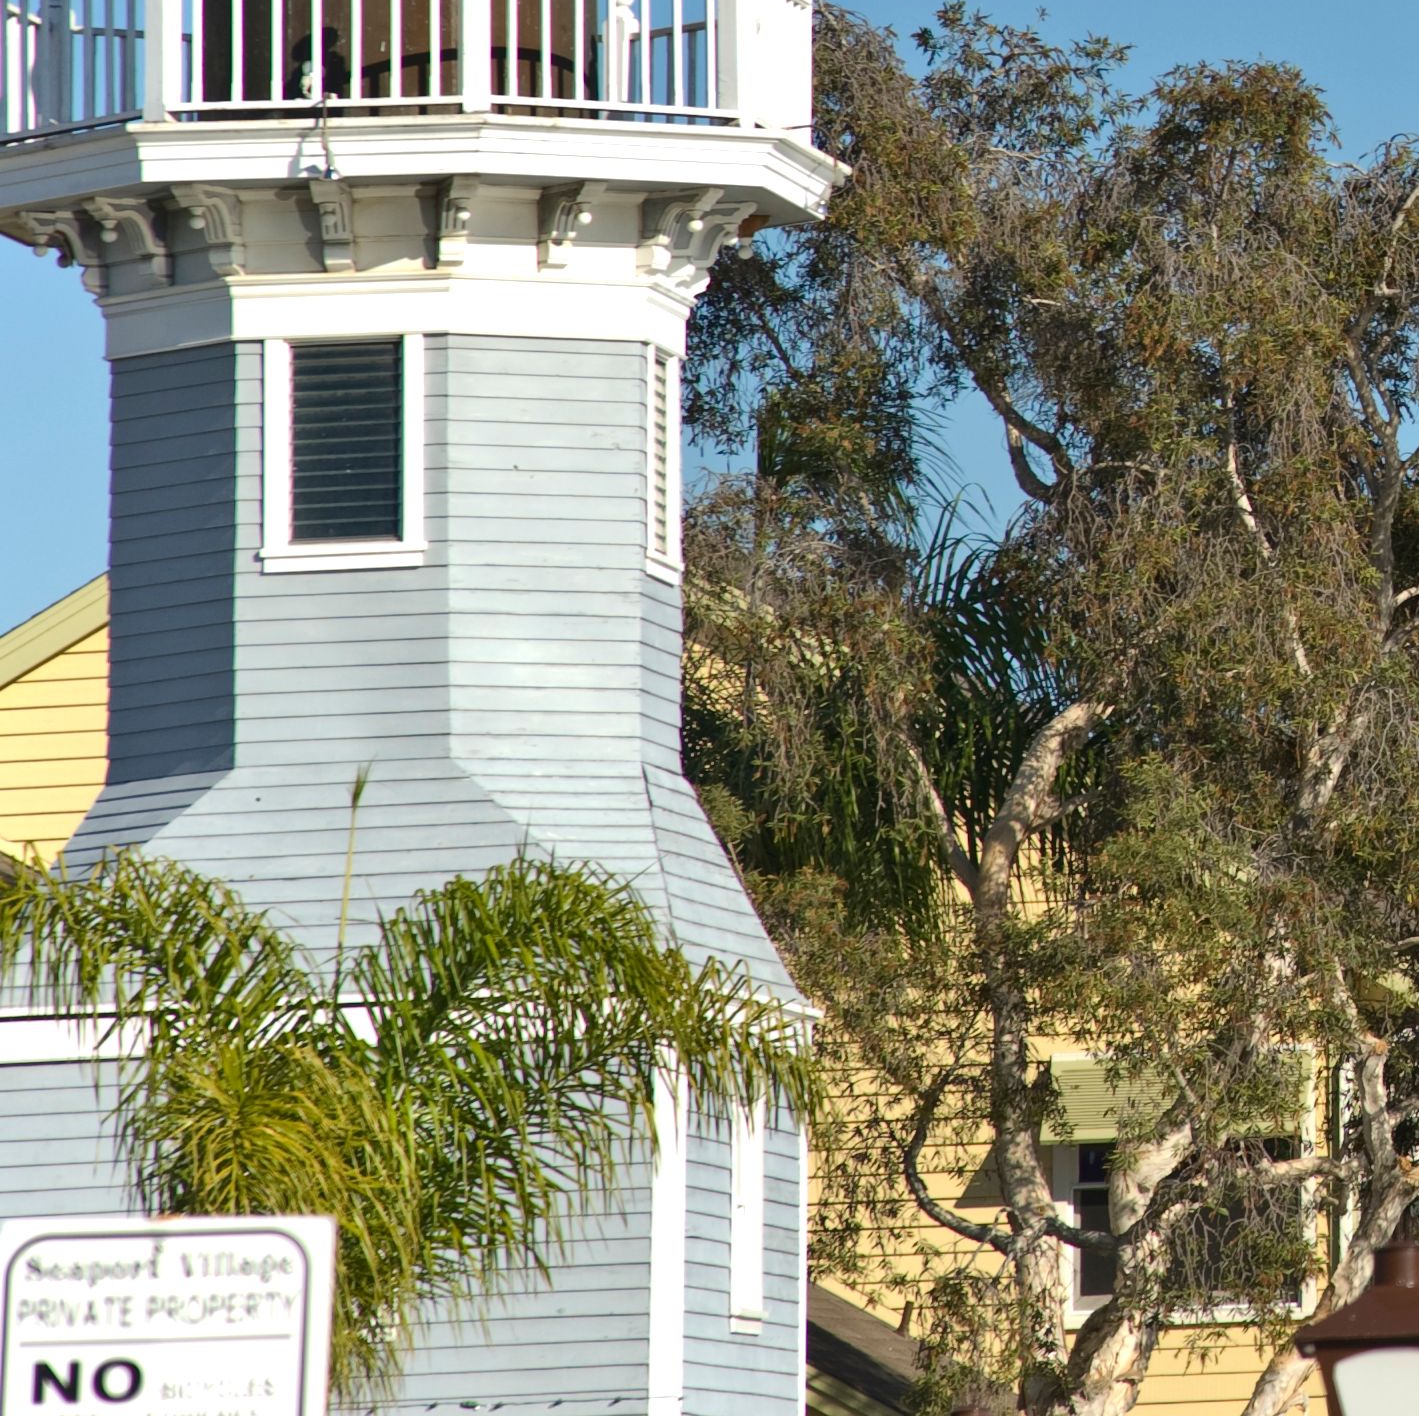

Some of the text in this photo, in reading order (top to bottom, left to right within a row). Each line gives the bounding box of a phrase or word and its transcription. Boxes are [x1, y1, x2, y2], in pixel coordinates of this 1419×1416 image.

[25, 1240, 295, 1286] Seaport Village
[16, 1292, 298, 1328] PRIVATE PROPERTY
[31, 1357, 144, 1405] NO
